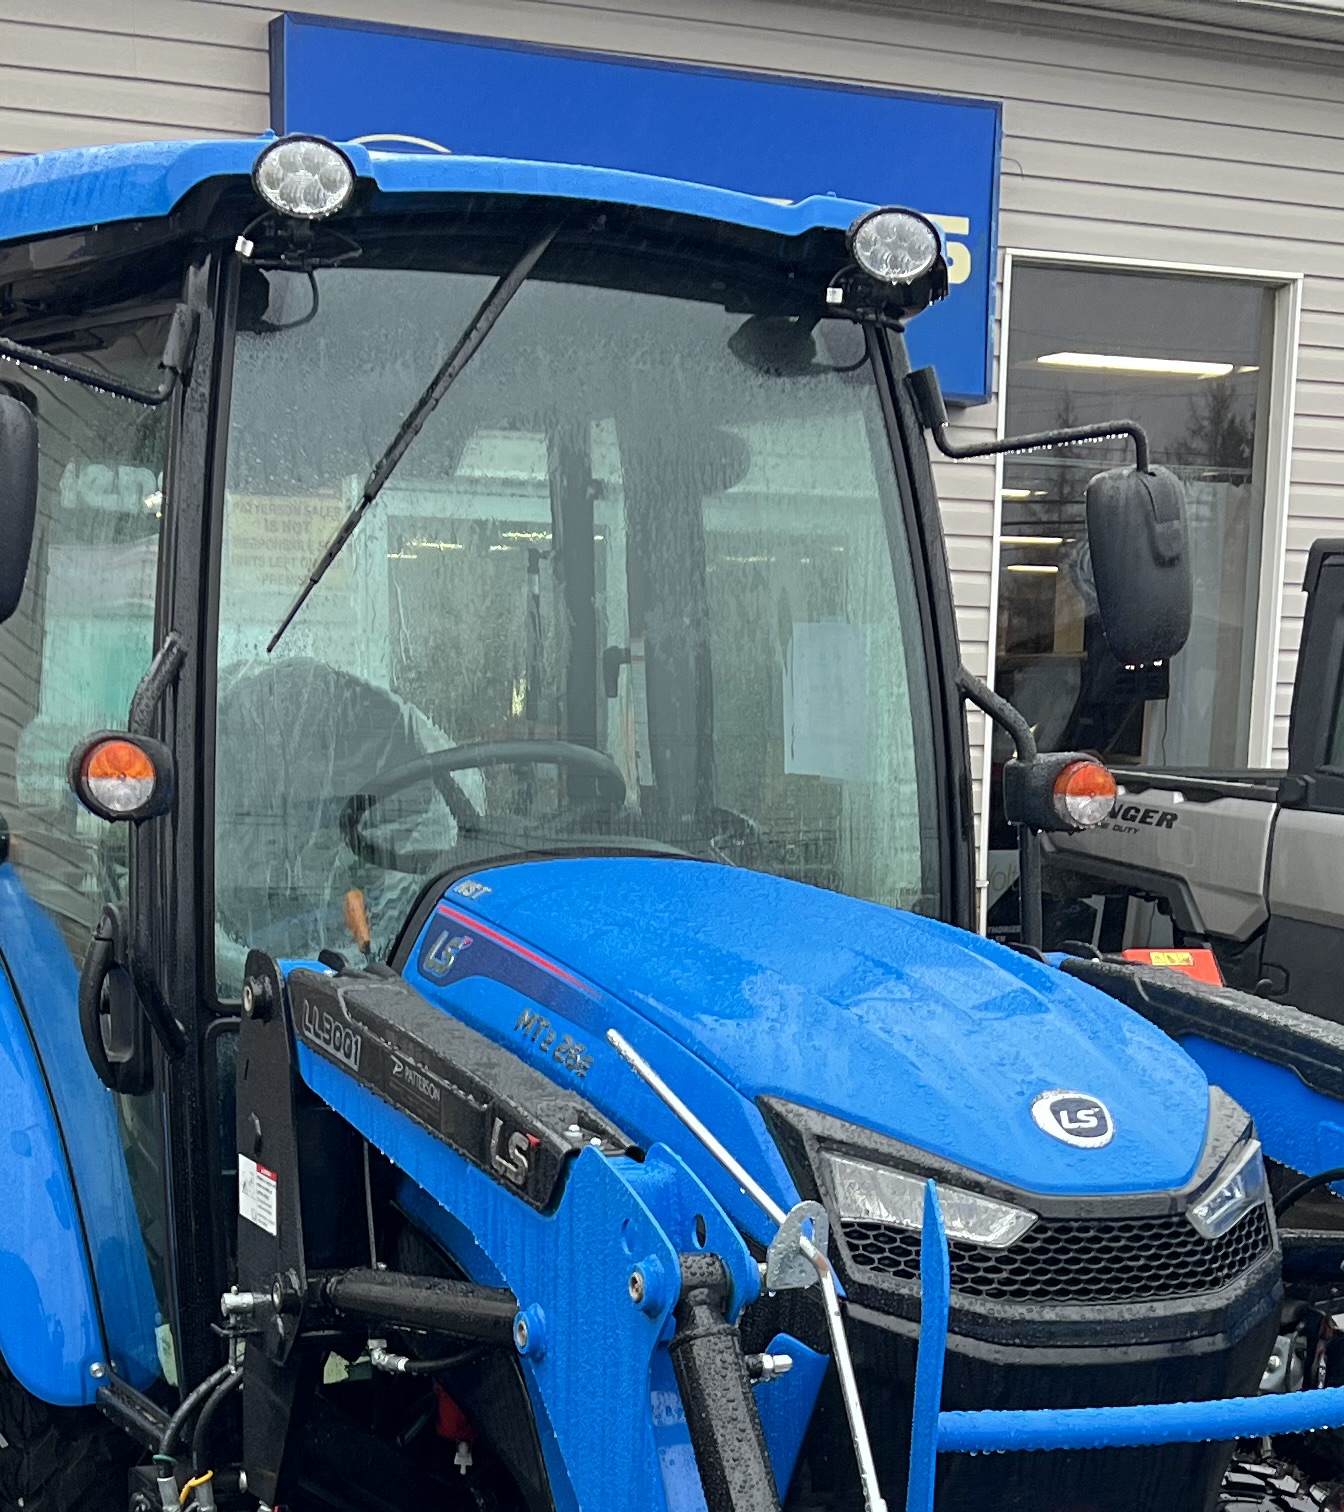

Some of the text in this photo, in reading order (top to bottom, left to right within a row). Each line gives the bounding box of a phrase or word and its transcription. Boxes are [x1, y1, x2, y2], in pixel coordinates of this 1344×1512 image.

[1109, 803, 1178, 829] NGER
[1112, 824, 1140, 835] DUTY
[422, 928, 473, 977] LS
[302, 1000, 362, 1073] LL3001
[405, 1067, 441, 1102] PATTERSON
[1059, 1107, 1100, 1129] LS
[491, 1116, 541, 1187] LS
